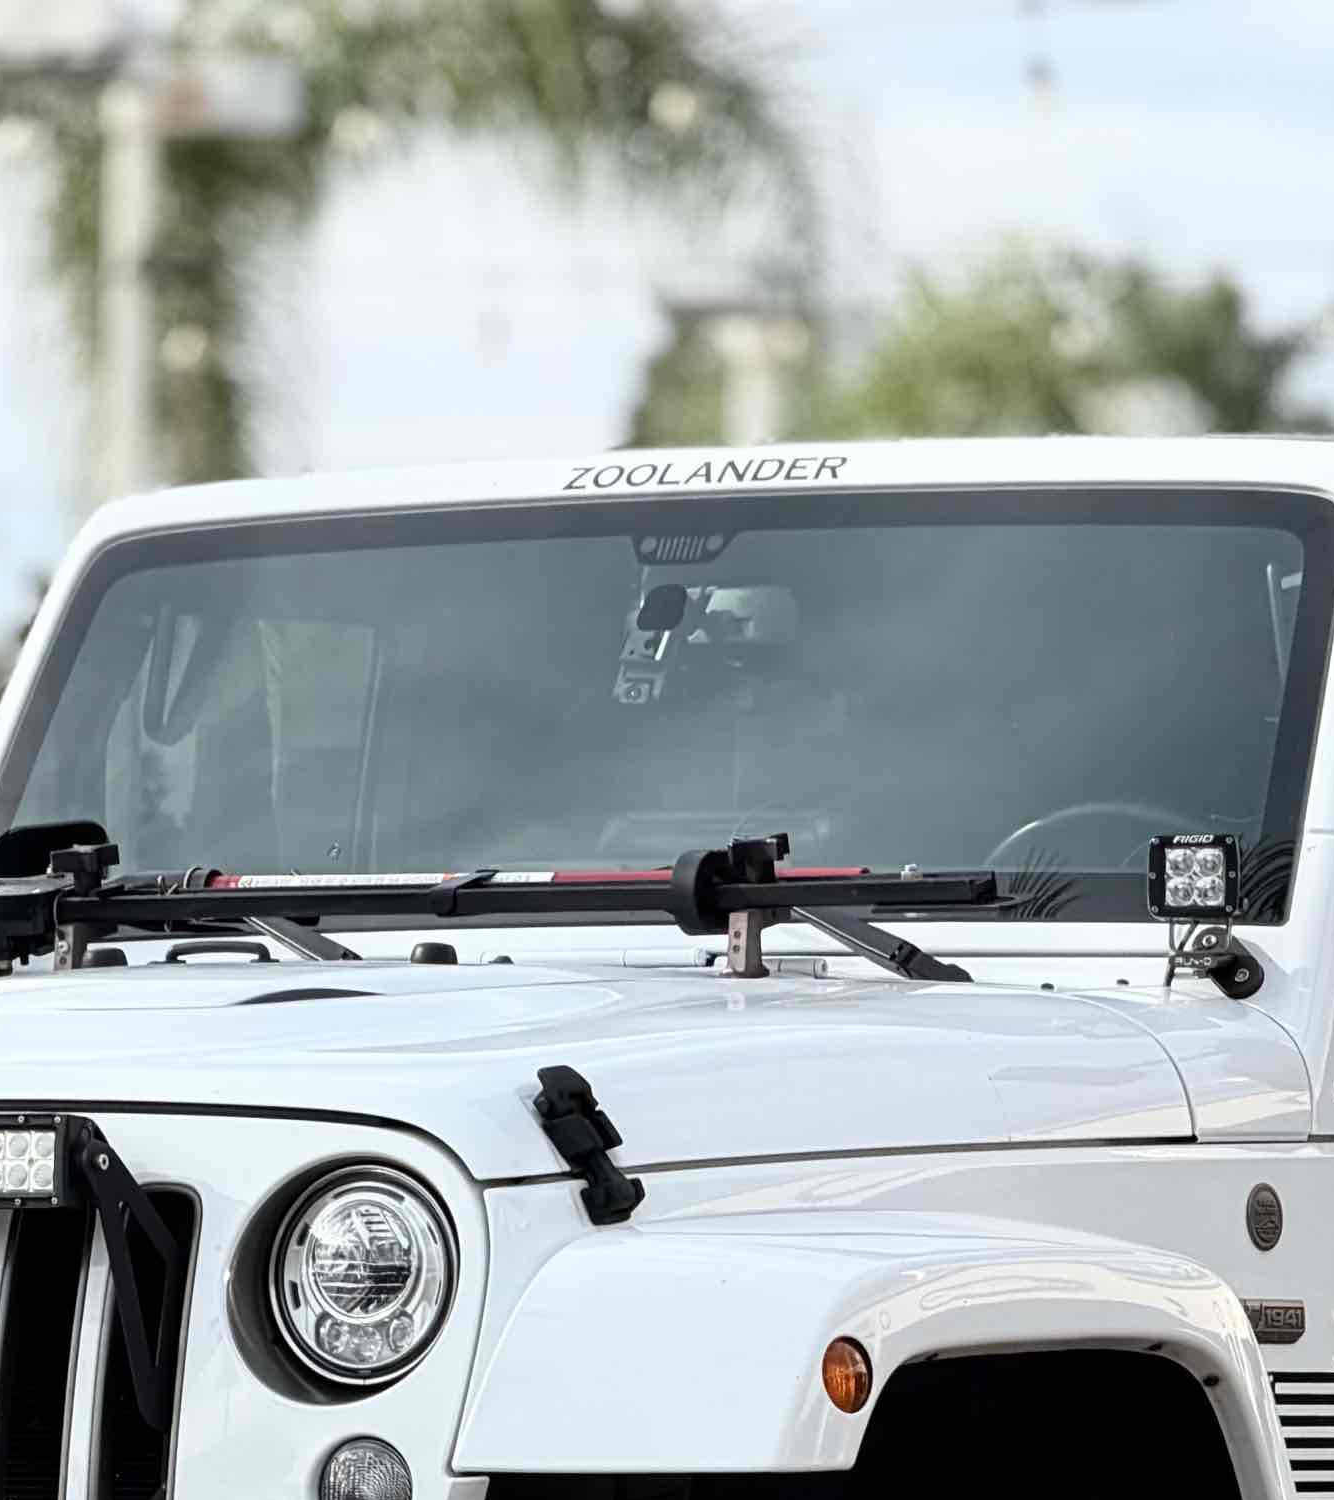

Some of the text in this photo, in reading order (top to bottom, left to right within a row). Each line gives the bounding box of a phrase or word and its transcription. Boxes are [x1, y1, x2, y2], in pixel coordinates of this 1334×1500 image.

[562, 456, 849, 490] ZOOLANDER
[1172, 834, 1214, 844] RIGID
[1265, 1308, 1303, 1328] 1941
